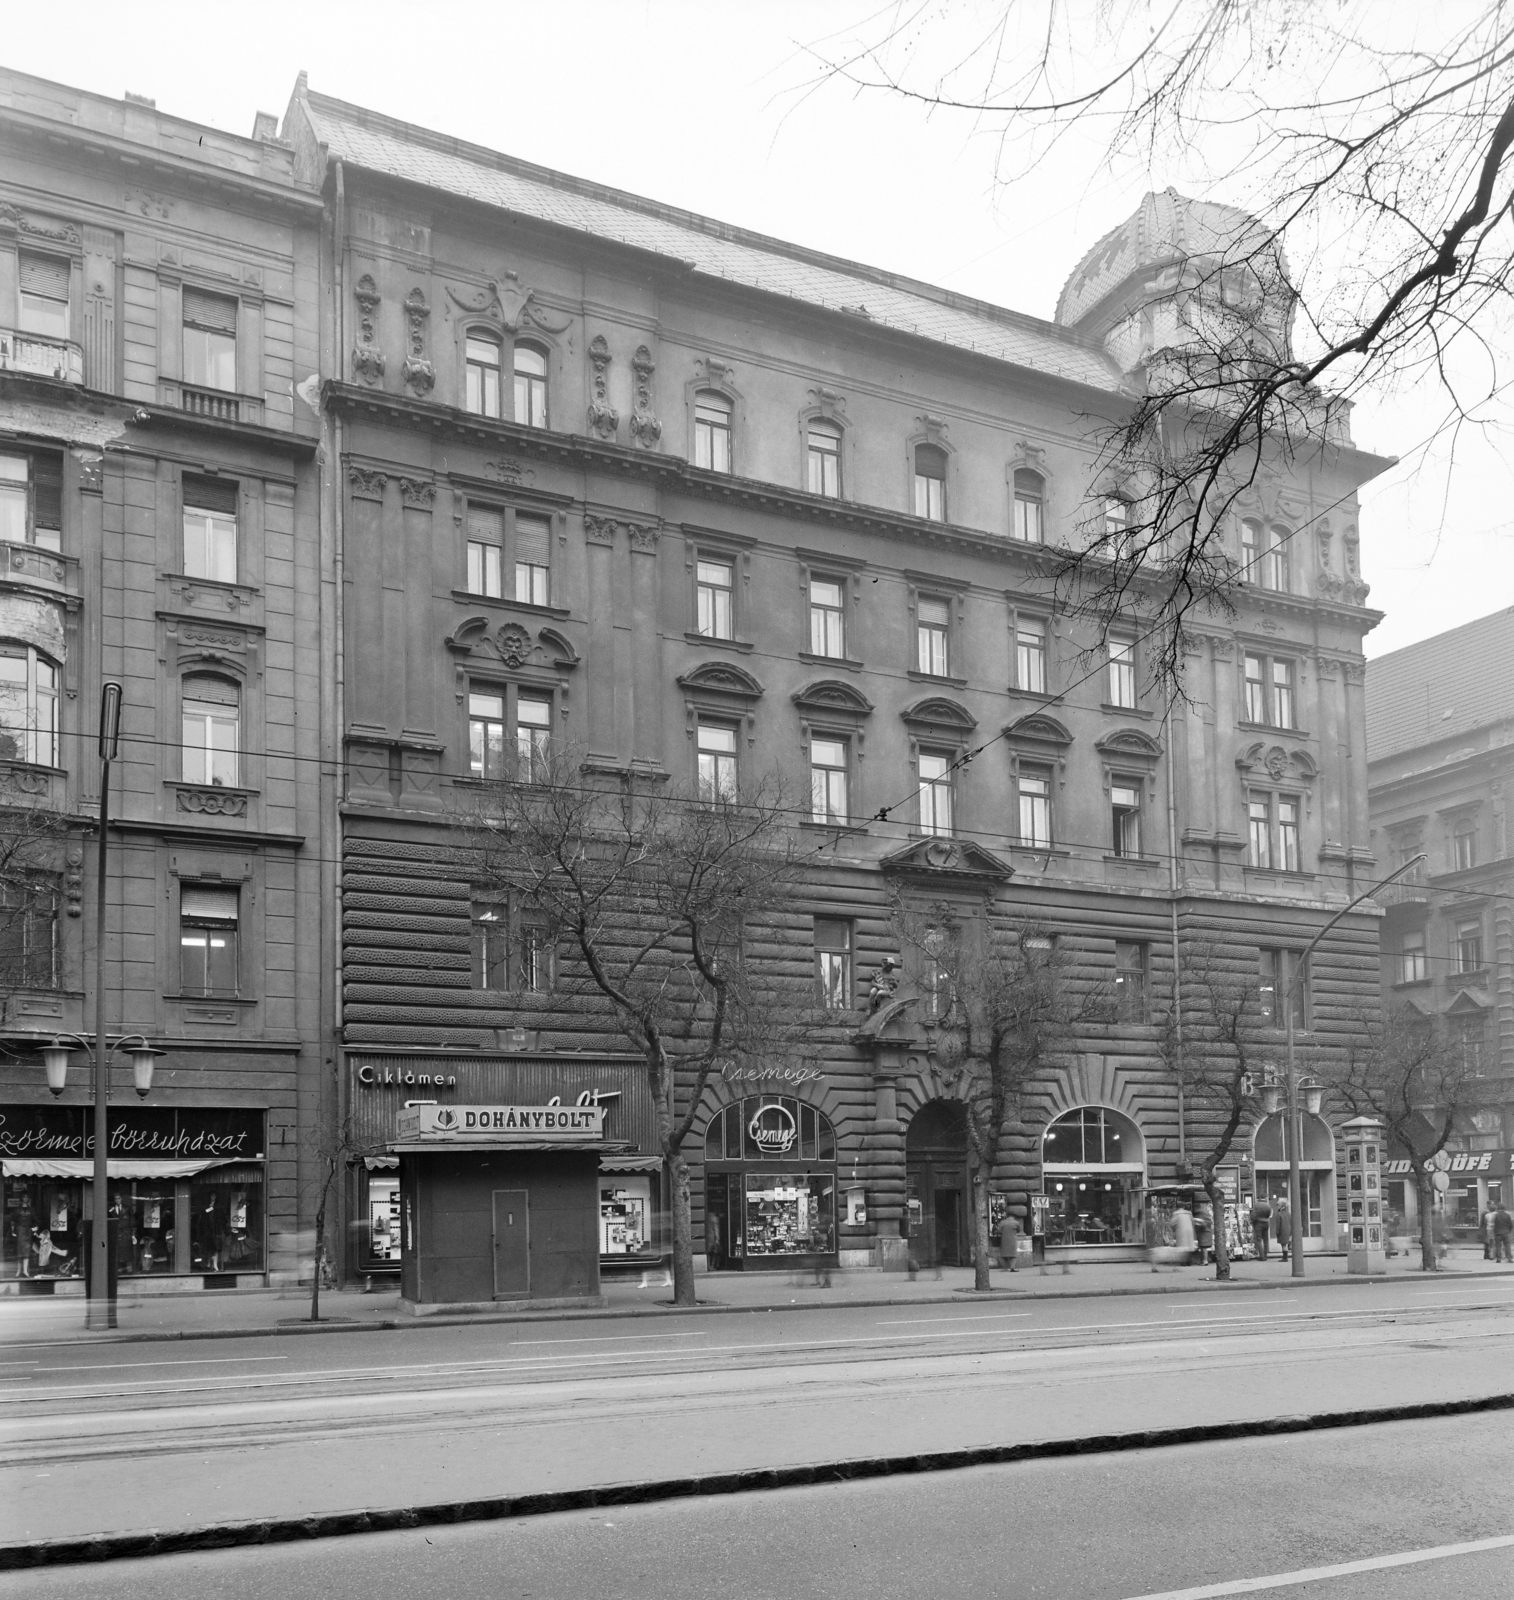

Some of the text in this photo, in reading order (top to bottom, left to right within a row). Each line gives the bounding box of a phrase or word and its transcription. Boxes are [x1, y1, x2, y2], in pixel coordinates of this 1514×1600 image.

[721, 1060, 826, 1086] Csemege
[465, 1107, 596, 1128] DOHÁNYBOLT
[749, 1120, 798, 1150] Csemege
